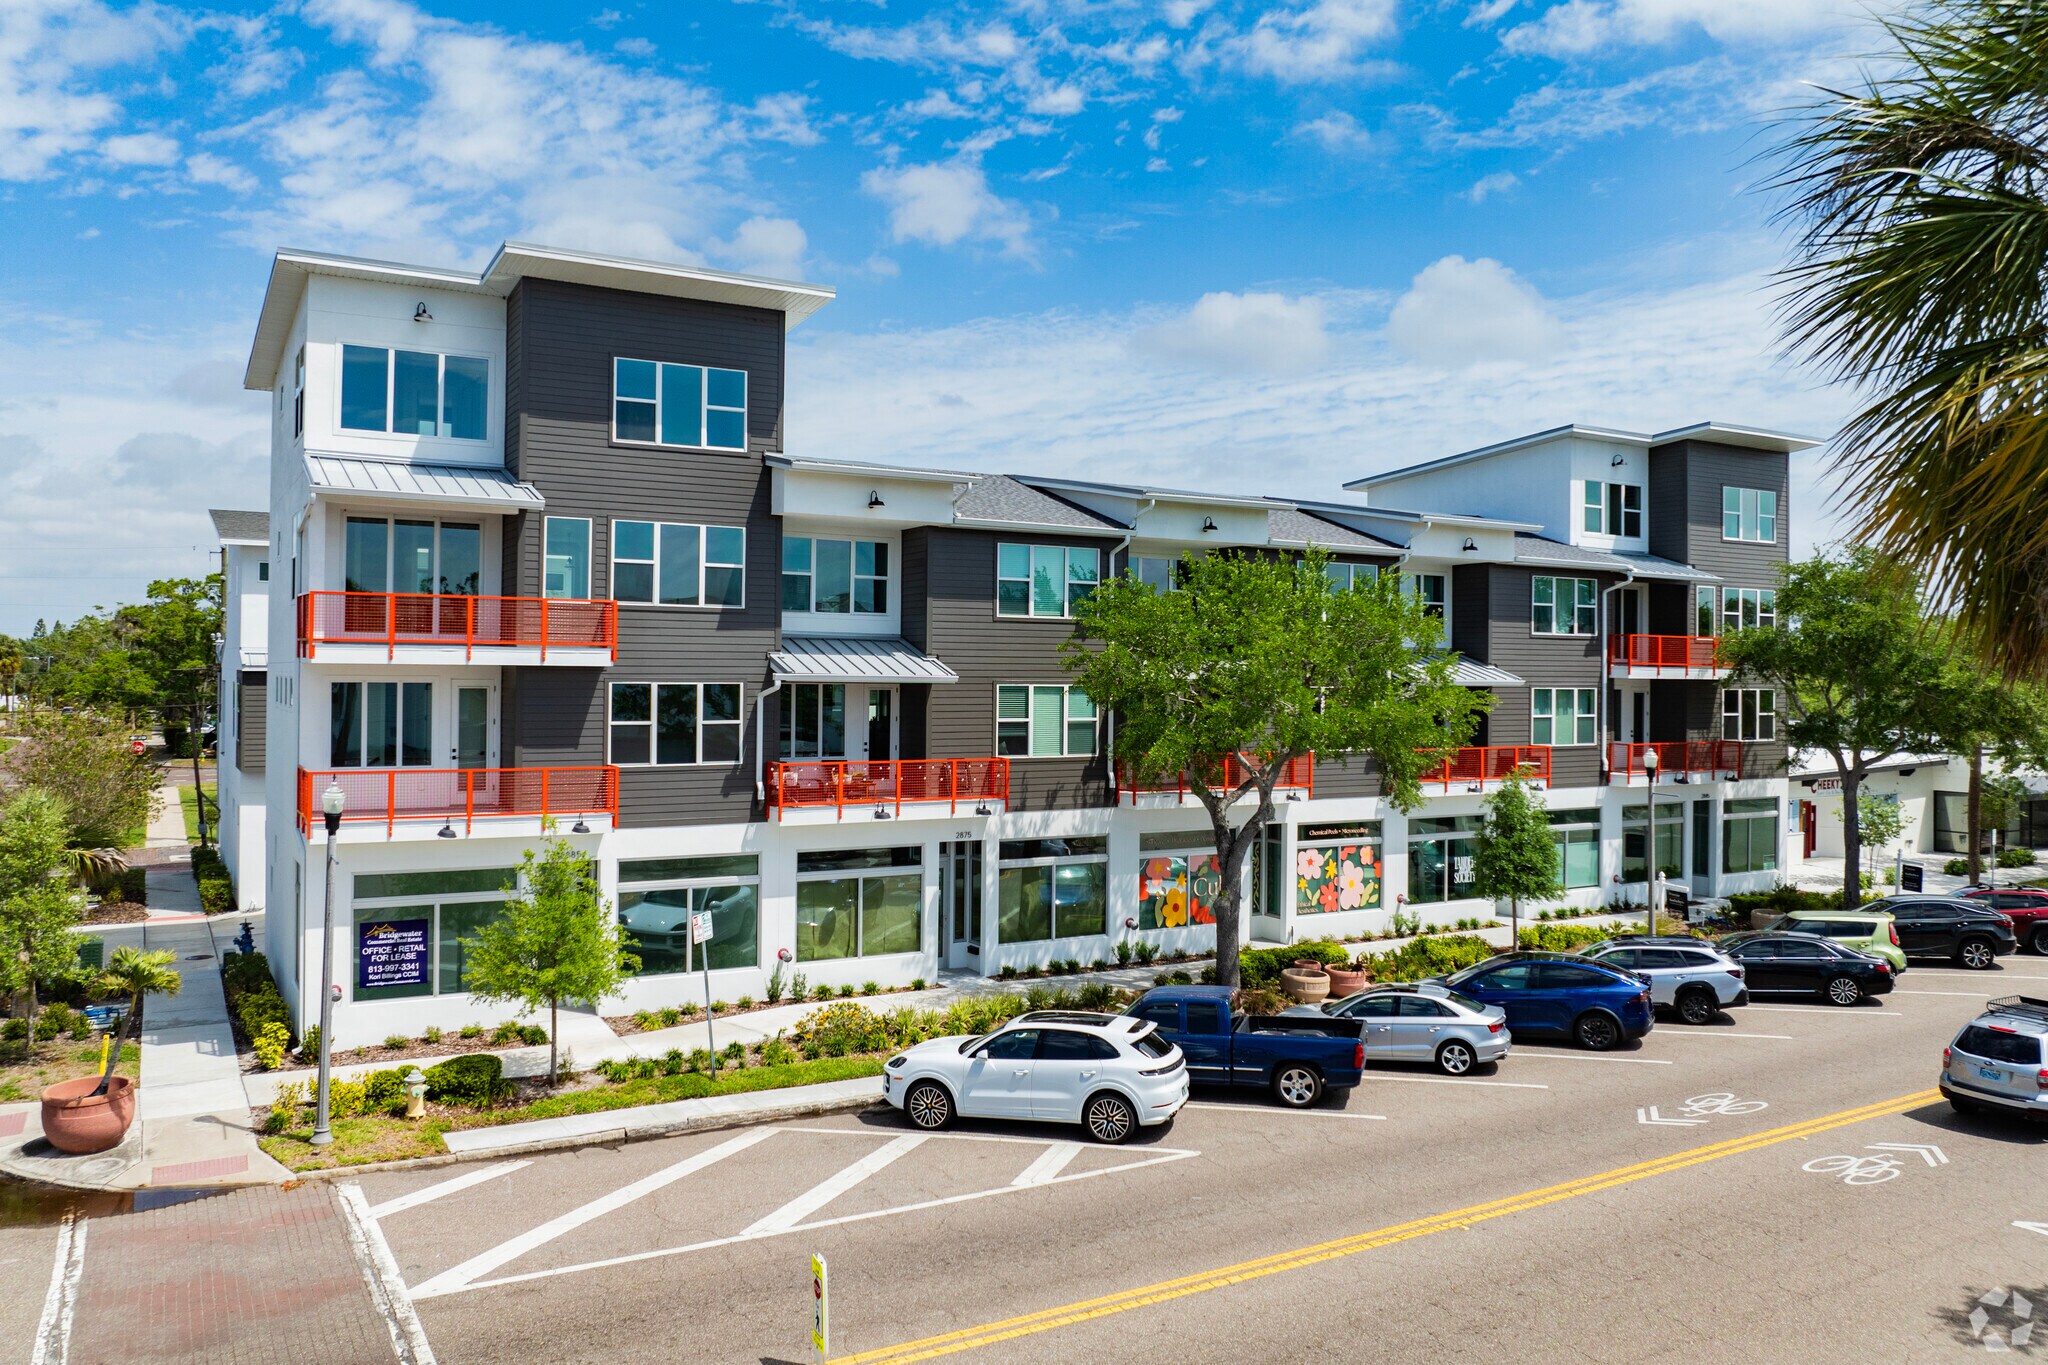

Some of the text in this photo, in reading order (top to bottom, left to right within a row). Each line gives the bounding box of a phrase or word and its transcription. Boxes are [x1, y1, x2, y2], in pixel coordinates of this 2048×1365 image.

[379, 931, 423, 939] Bridgewater
[362, 944, 426, 955] OFFICE RETAIL
[390, 952, 417, 961] LEASE
[368, 963, 419, 973] 813-997-3341
